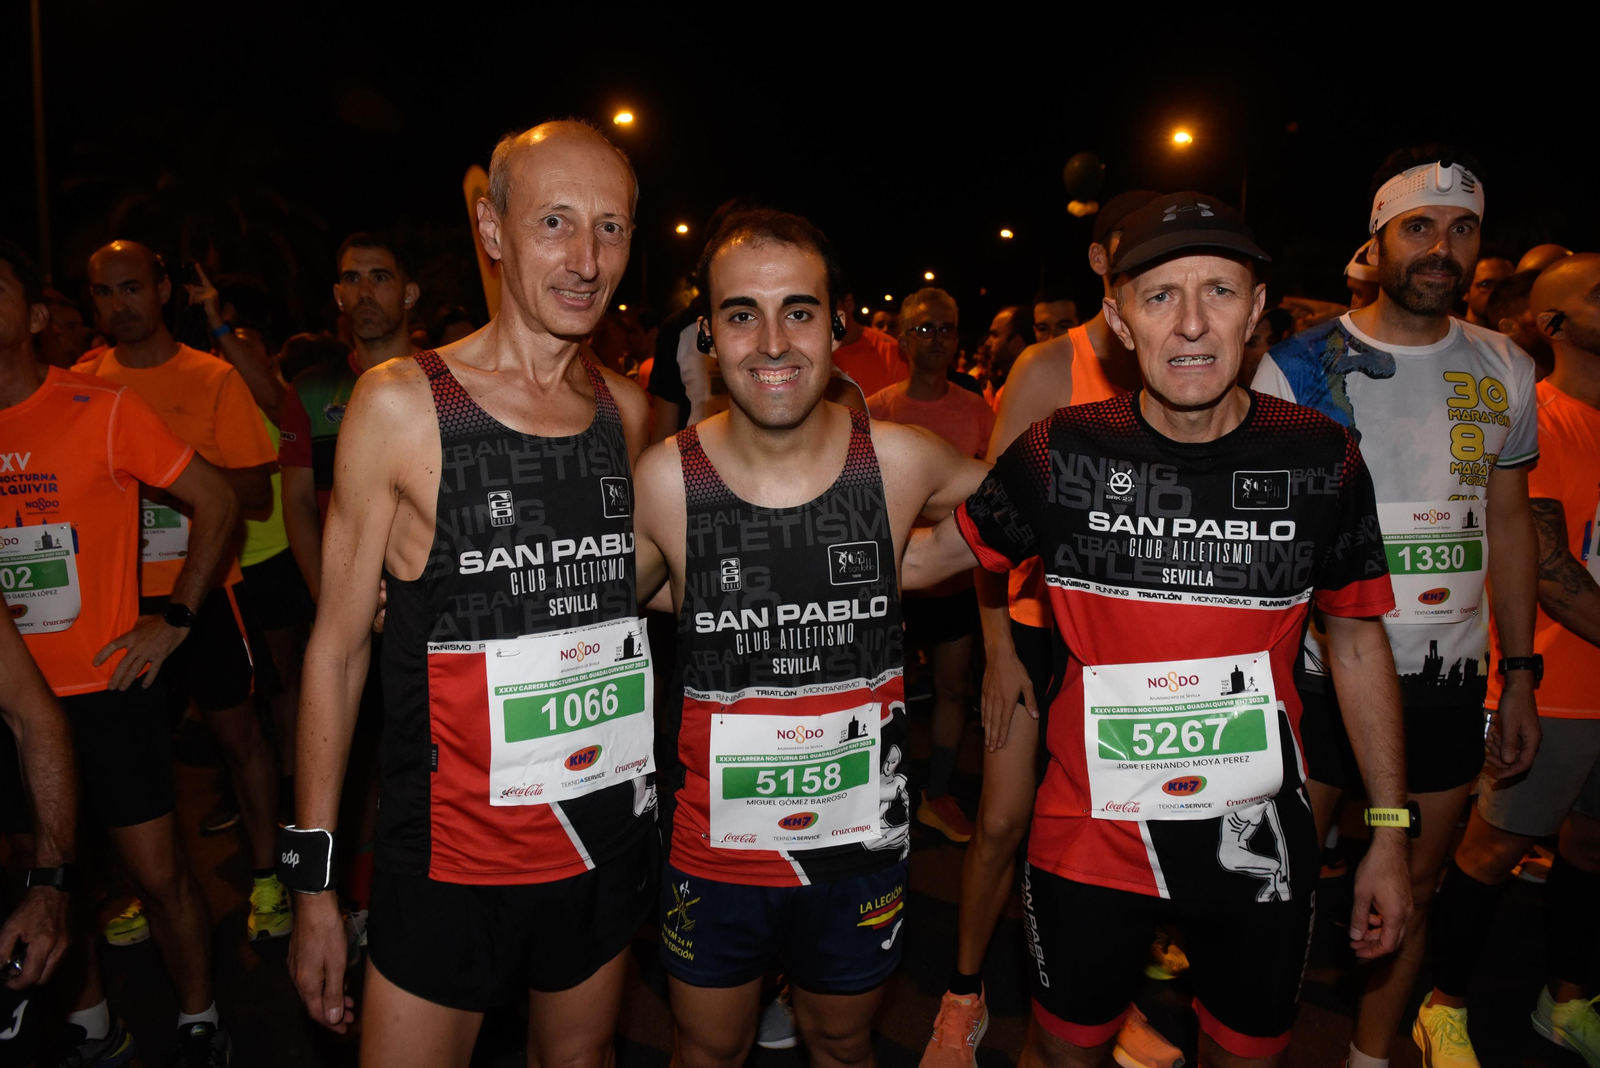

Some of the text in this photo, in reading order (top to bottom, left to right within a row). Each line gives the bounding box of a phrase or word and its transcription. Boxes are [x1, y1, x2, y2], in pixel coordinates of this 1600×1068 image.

[1443, 371, 1510, 413] 30
[1448, 408, 1511, 428] MARATÓN
[1450, 423, 1485, 462] 8
[1088, 510, 1296, 542] SAN PABLO
[459, 542, 545, 575] SAN
[1128, 537, 1162, 560] CLUB
[1172, 540, 1253, 565] ATLETISMO
[1398, 544, 1466, 571] 1330
[510, 567, 547, 596] CLUB
[556, 557, 625, 589] ATLETISMO
[1161, 567, 1214, 588] SEVILLA
[549, 592, 598, 617] SEVILLA
[1095, 585, 1129, 597] RUNNING
[1137, 590, 1182, 601] TRIATLÓN
[1191, 594, 1251, 606] MONTAÑISMO
[1259, 599, 1291, 608] RUNNING
[694, 595, 888, 634] SAN PABLO
[735, 629, 771, 656] CLUB
[780, 622, 854, 650] ATLETISMO
[498, 661, 647, 694] XXXV CARRERA NOCTURNA DEL GUADALQUIVIR KH7 2023
[772, 655, 821, 675] SEVILLA
[755, 689, 797, 698] TRIATLÓN
[803, 681, 860, 695] MONTAÑISMO
[541, 683, 619, 731] 1066
[1111, 706, 1138, 714] CARRERA
[1138, 705, 1174, 713] NOCTURNA
[1186, 700, 1235, 710] GUADALQUIVIR
[1235, 698, 1248, 706] KH7
[1248, 696, 1264, 704] 2023
[1132, 717, 1228, 756] 5267
[765, 754, 798, 762] NOCTURNA
[809, 745, 848, 759] GUADALQUIVIR
[848, 742, 859, 750] KH7
[859, 740, 872, 748] 2023
[1140, 760, 1190, 770] FERNANDO
[1192, 758, 1221, 767] MOYA
[1223, 755, 1250, 764] PEREZ
[755, 762, 842, 795] 5158
[779, 797, 808, 806] GÓMEZ
[810, 792, 848, 805] BARROSO
[1226, 793, 1270, 807] Cruzcampo
[831, 824, 871, 836] Cruzcampo
[860, 884, 903, 915] LA LEGIÓN
[1028, 913, 1051, 989] PABLO
